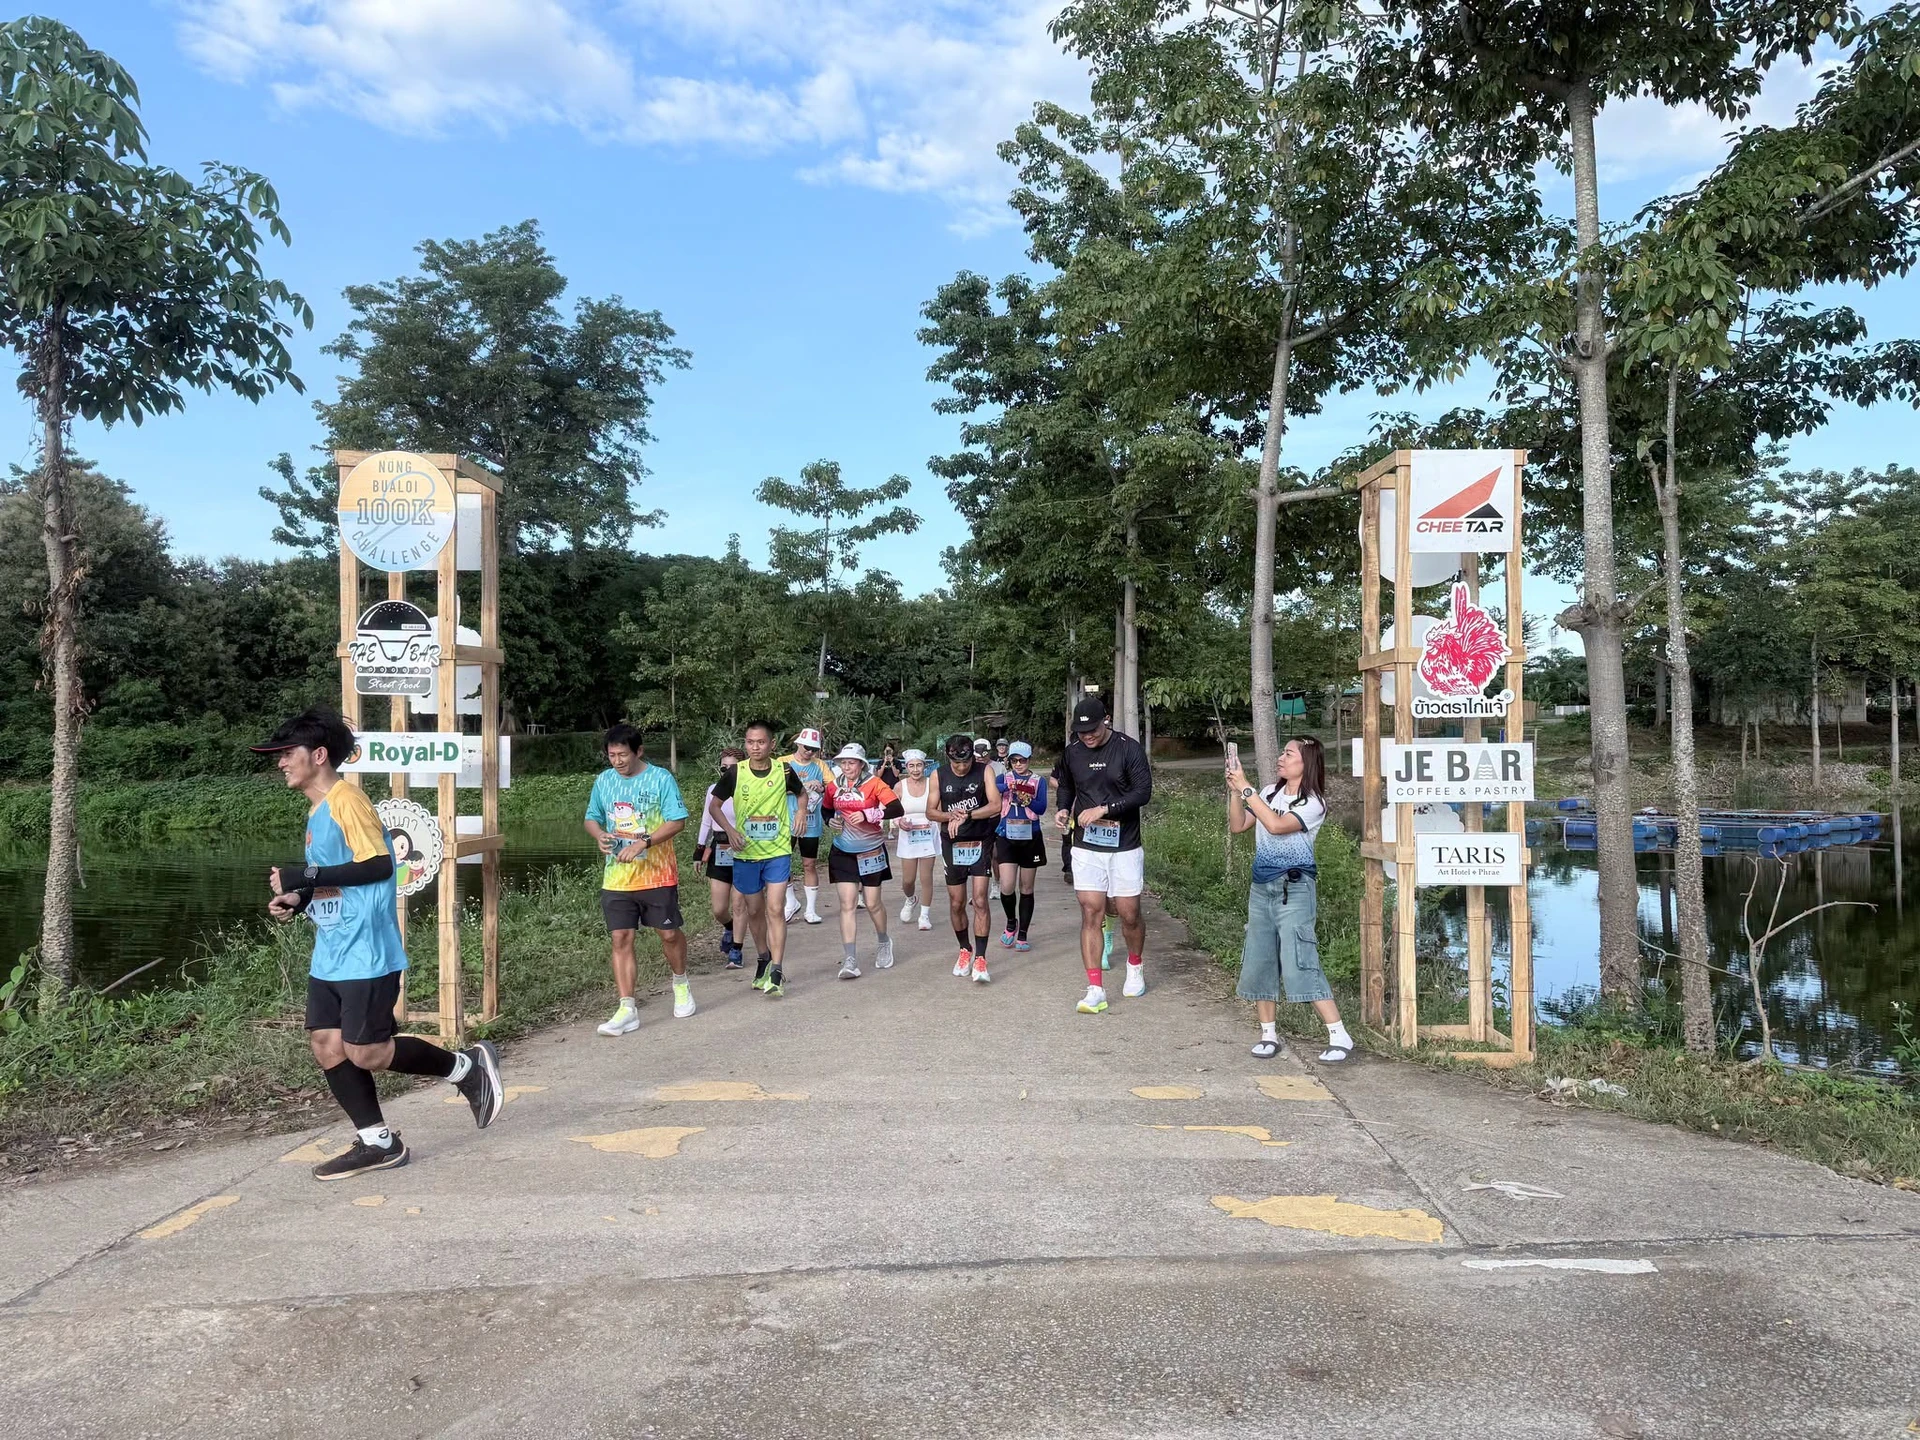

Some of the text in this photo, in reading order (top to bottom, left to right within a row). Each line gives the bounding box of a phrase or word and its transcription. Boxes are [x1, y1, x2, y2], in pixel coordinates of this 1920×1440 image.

[378, 460, 412, 472] NONG
[372, 480, 418, 493] BUALOI
[357, 498, 435, 525] 100K
[1416, 521, 1504, 532] CHEETAR
[352, 531, 439, 565] CHALLENGE
[349, 642, 440, 664] THE BAR
[368, 678, 420, 690] Street Food
[1415, 698, 1503, 715] ข้าวตราไก่แจ้
[369, 742, 459, 766] Royal-D
[1395, 750, 1523, 782] JE BAR
[1396, 787, 1450, 796] COFFEE
[1475, 787, 1526, 795] PASTRY
[762, 823, 777, 831] 108
[1090, 826, 1117, 837] M 105
[1431, 847, 1505, 864] TARIS
[321, 900, 339, 914] 101
